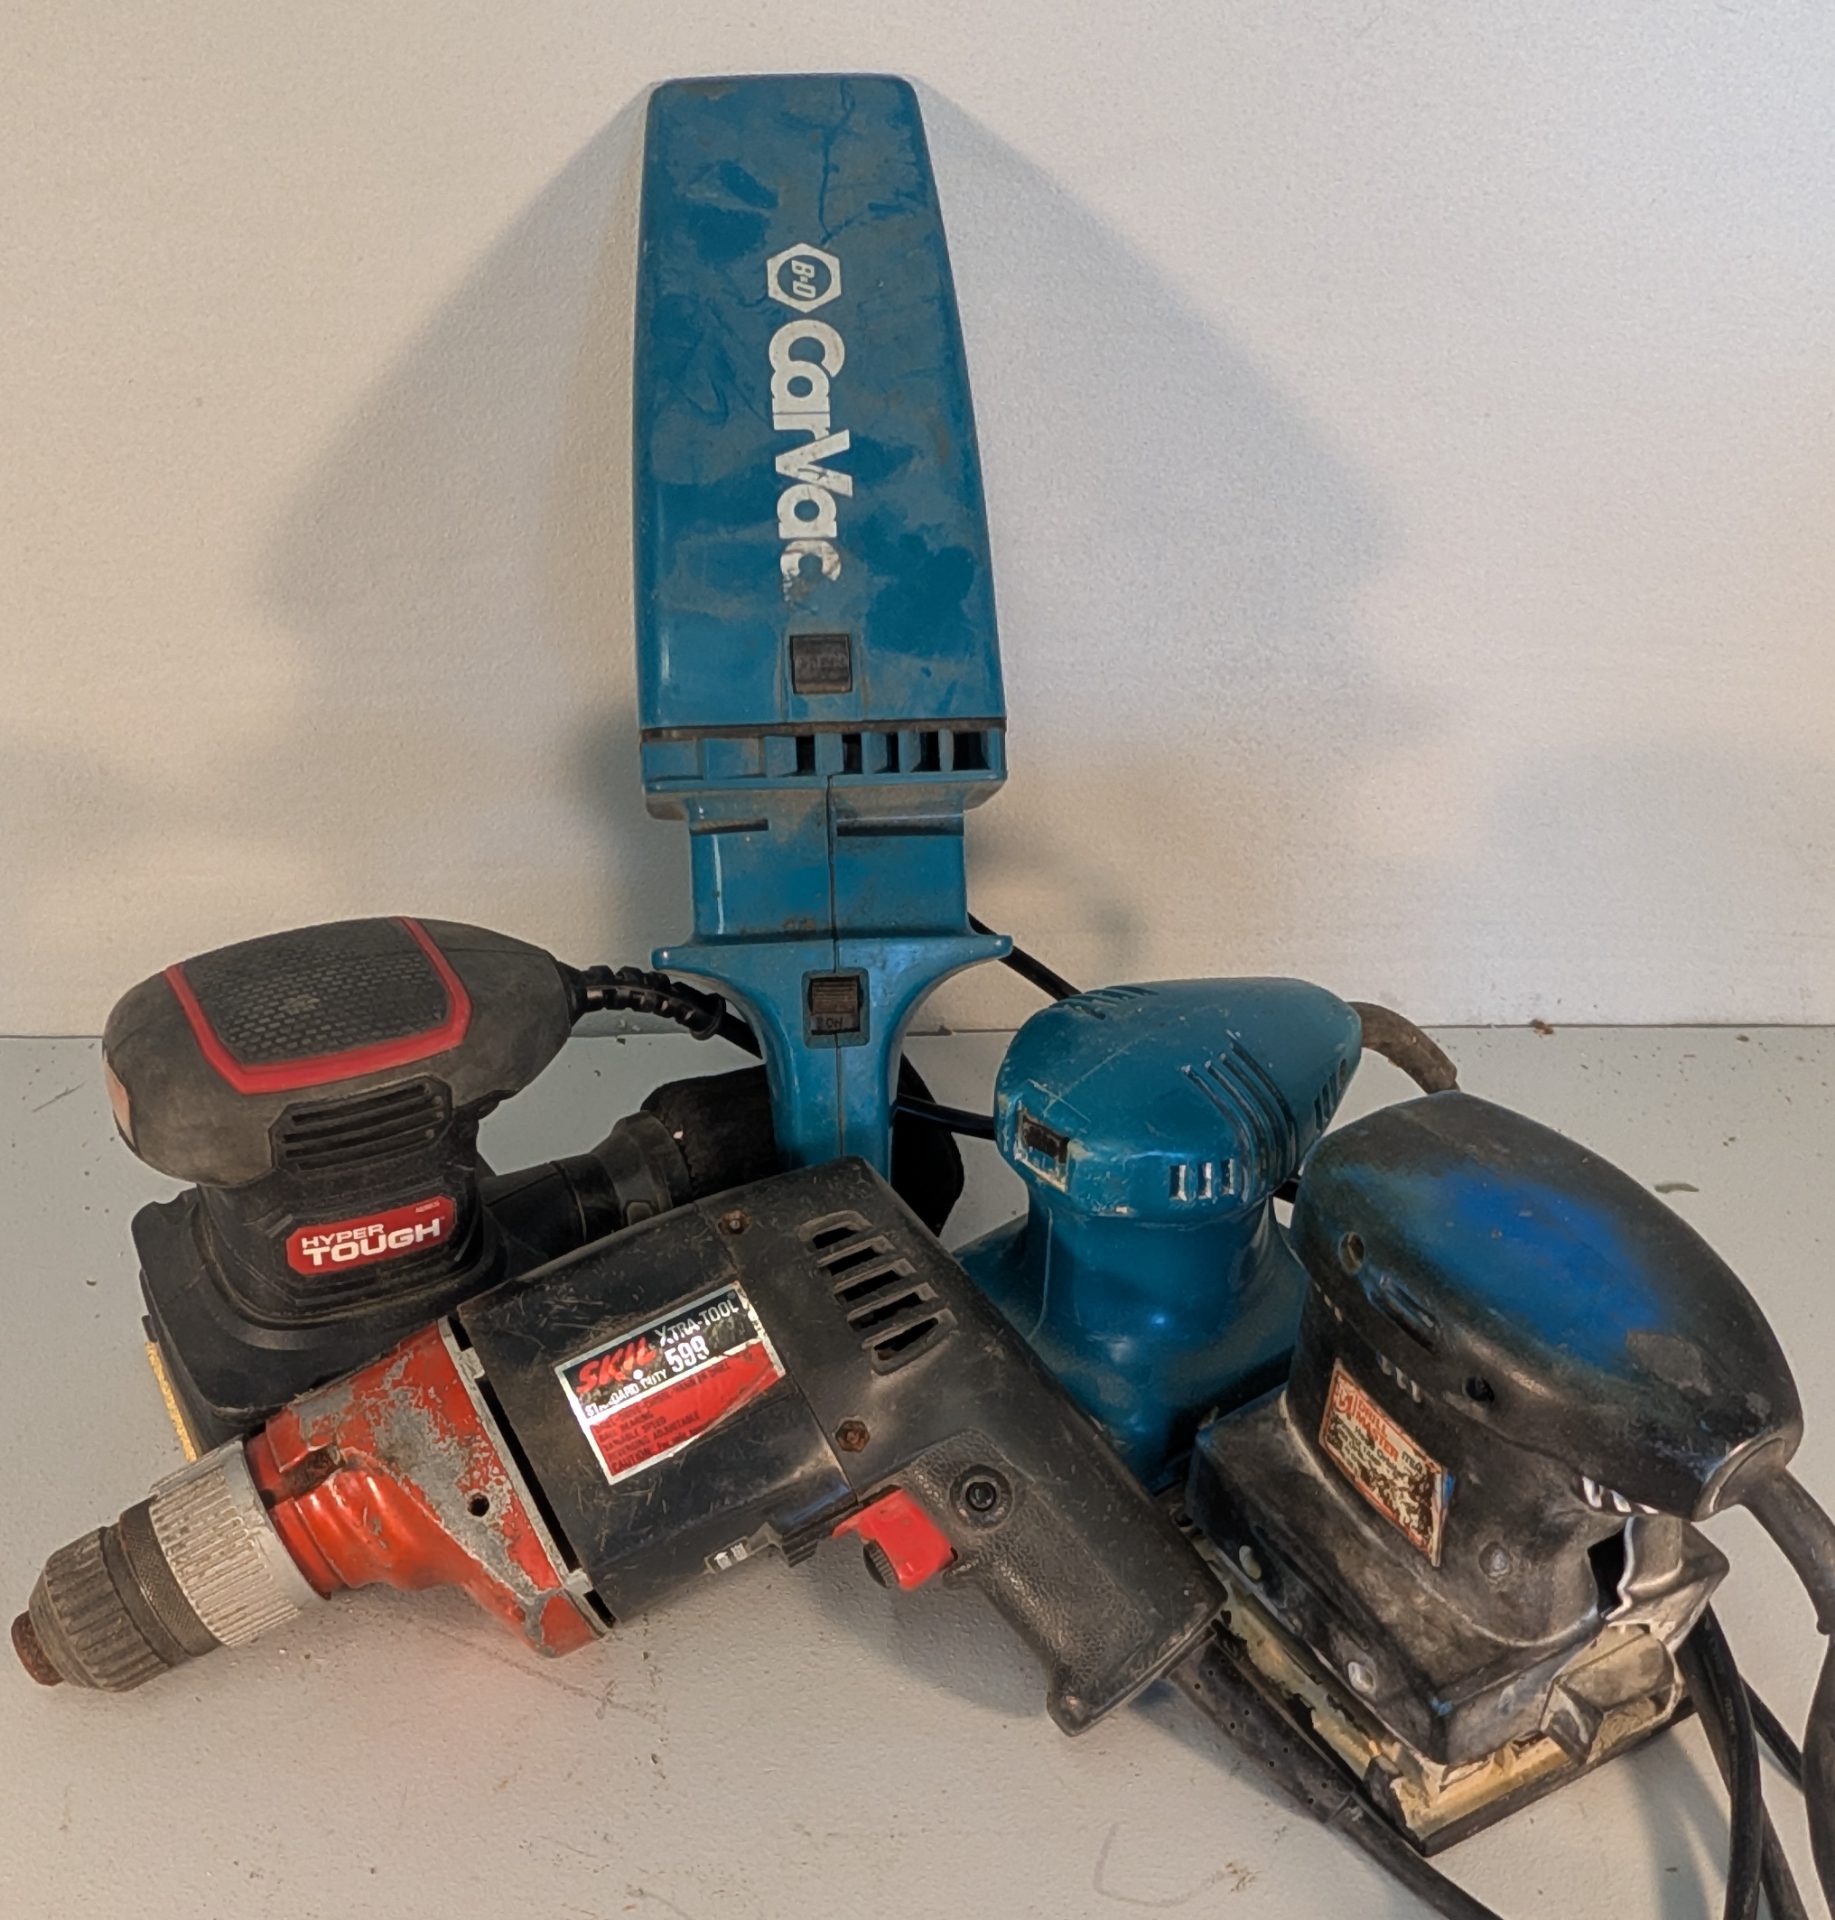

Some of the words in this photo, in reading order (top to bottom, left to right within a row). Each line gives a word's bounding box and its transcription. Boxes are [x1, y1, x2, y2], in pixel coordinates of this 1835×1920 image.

[302, 1223, 385, 1249] HYPER
[303, 1218, 440, 1266] TOUGH
[655, 1299, 739, 1347] XTRA-TOOL
[576, 1337, 657, 1392] SKIL
[665, 1335, 710, 1373] 599
[1356, 1411, 1399, 1462] MASTER
[1359, 1400, 1387, 1438] DRILL
